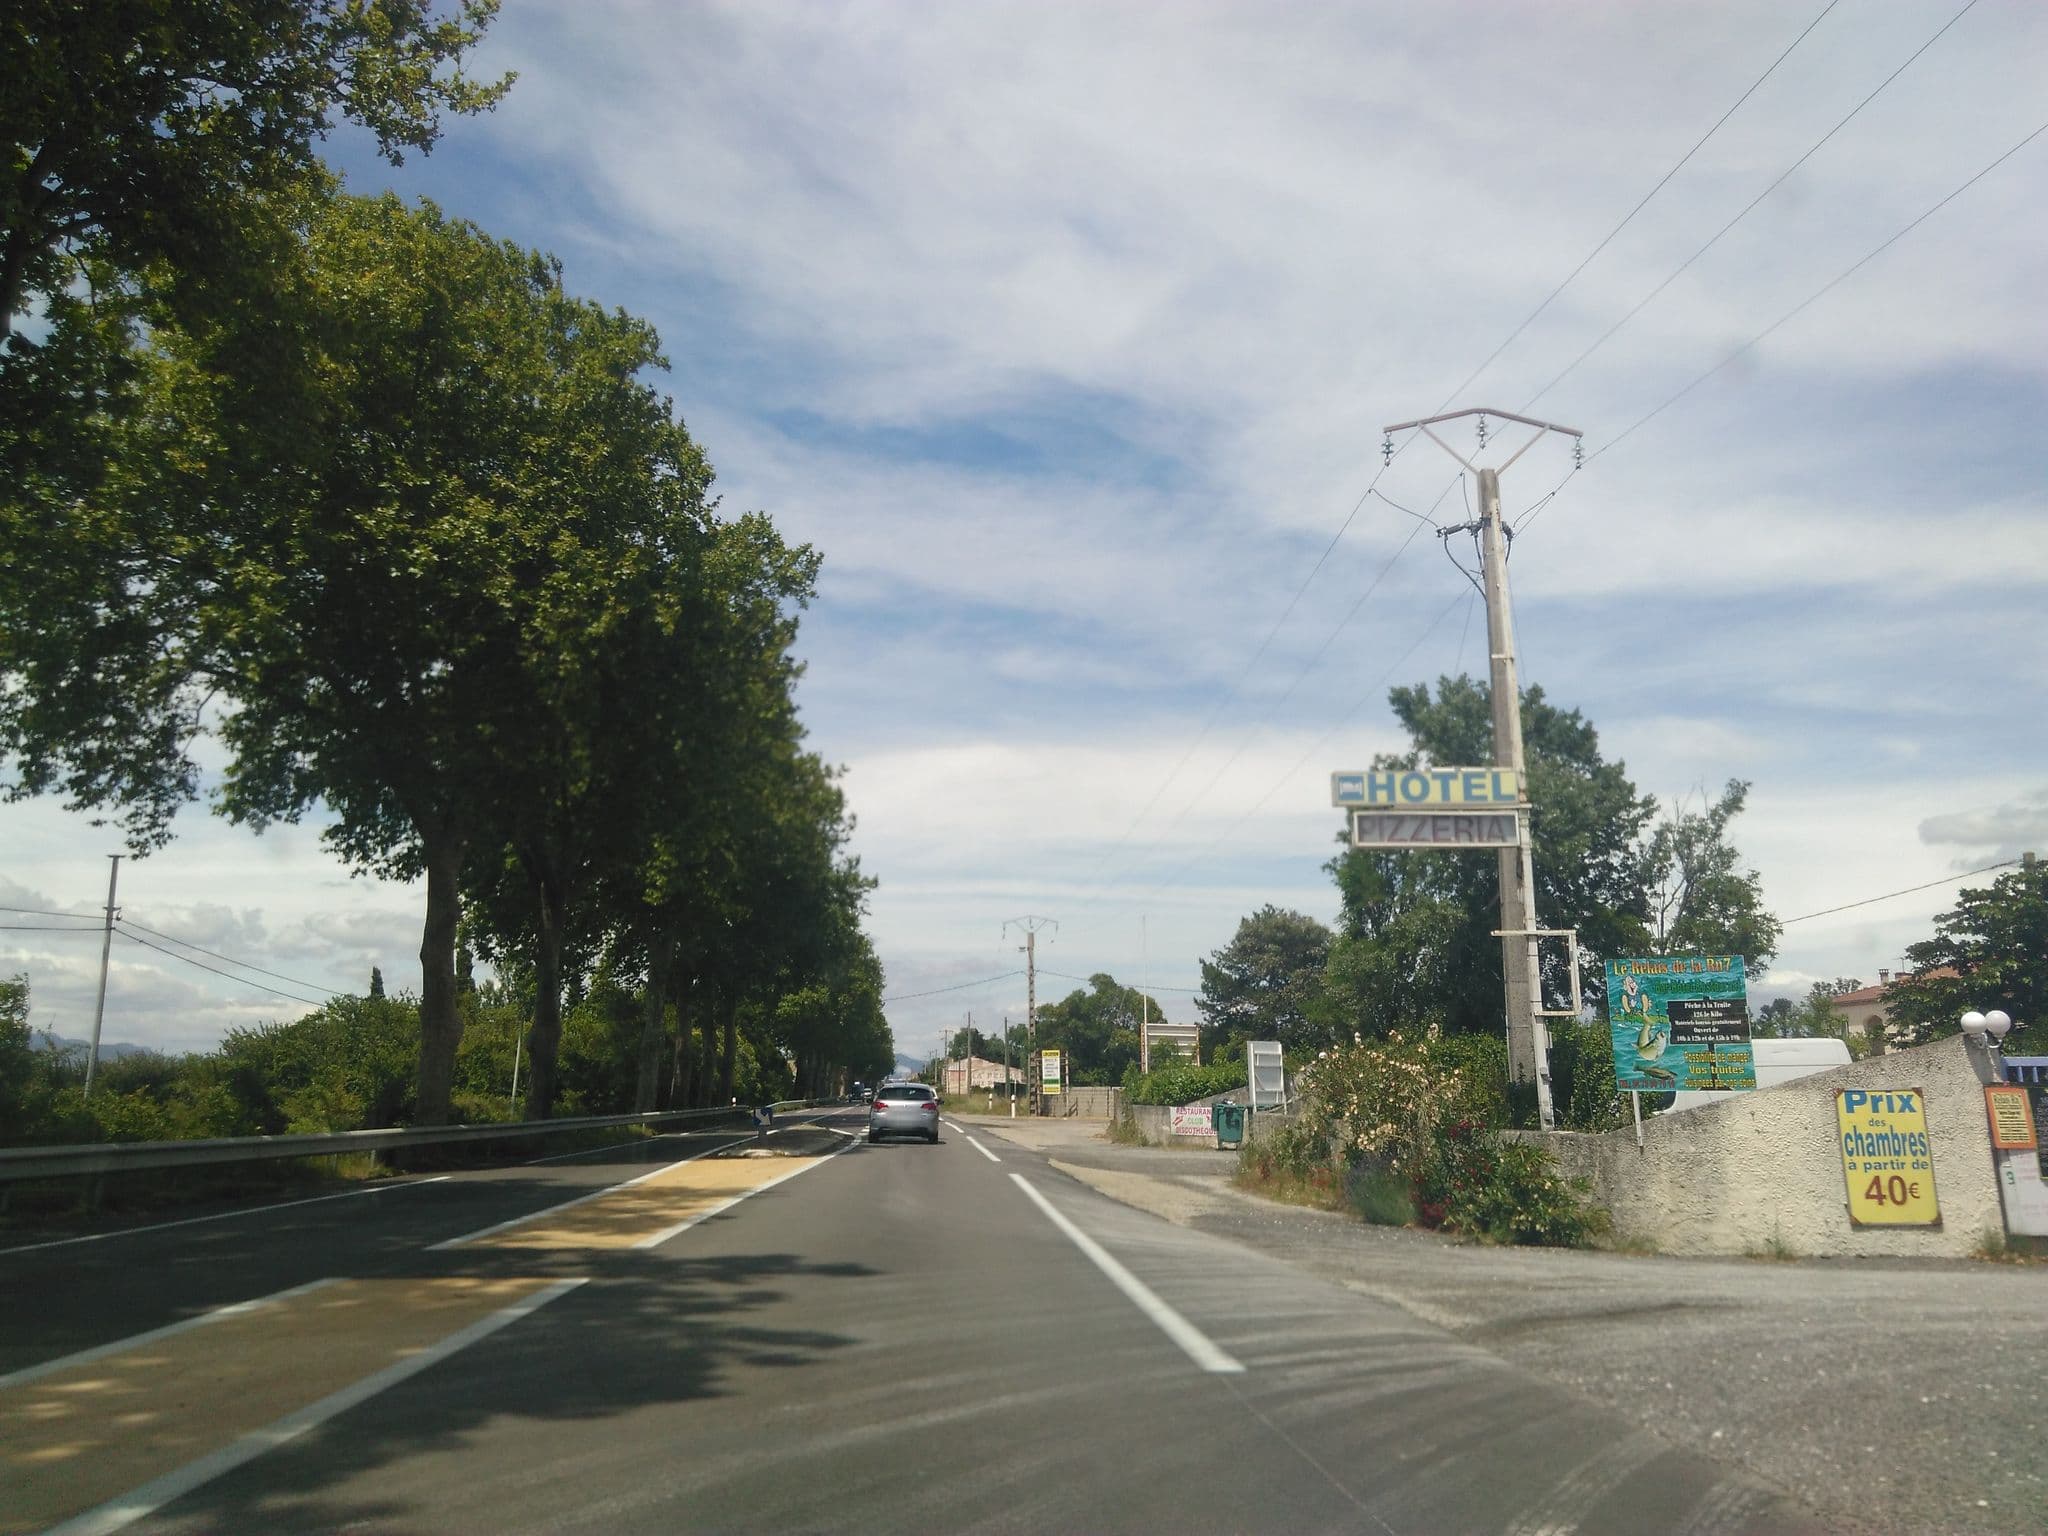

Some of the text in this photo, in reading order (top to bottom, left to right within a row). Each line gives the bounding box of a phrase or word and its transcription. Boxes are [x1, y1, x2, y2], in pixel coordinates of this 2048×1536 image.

[1368, 772, 1516, 803] HOTEL
[1358, 815, 1508, 843] PIZZERIA
[1613, 960, 1628, 976] Le
[1631, 960, 1669, 975] Relais
[1673, 959, 1687, 973] de
[1690, 959, 1702, 973] la
[1689, 1065, 1745, 1075] Vos truites
[1175, 1107, 1212, 1115] RESTAURAN
[1844, 1091, 1918, 1114] Prix
[1868, 1118, 1886, 1127] des
[1844, 1125, 1928, 1157] chambres
[1848, 1158, 1929, 1173] à partir de
[1864, 1175, 1921, 1207] 40€
